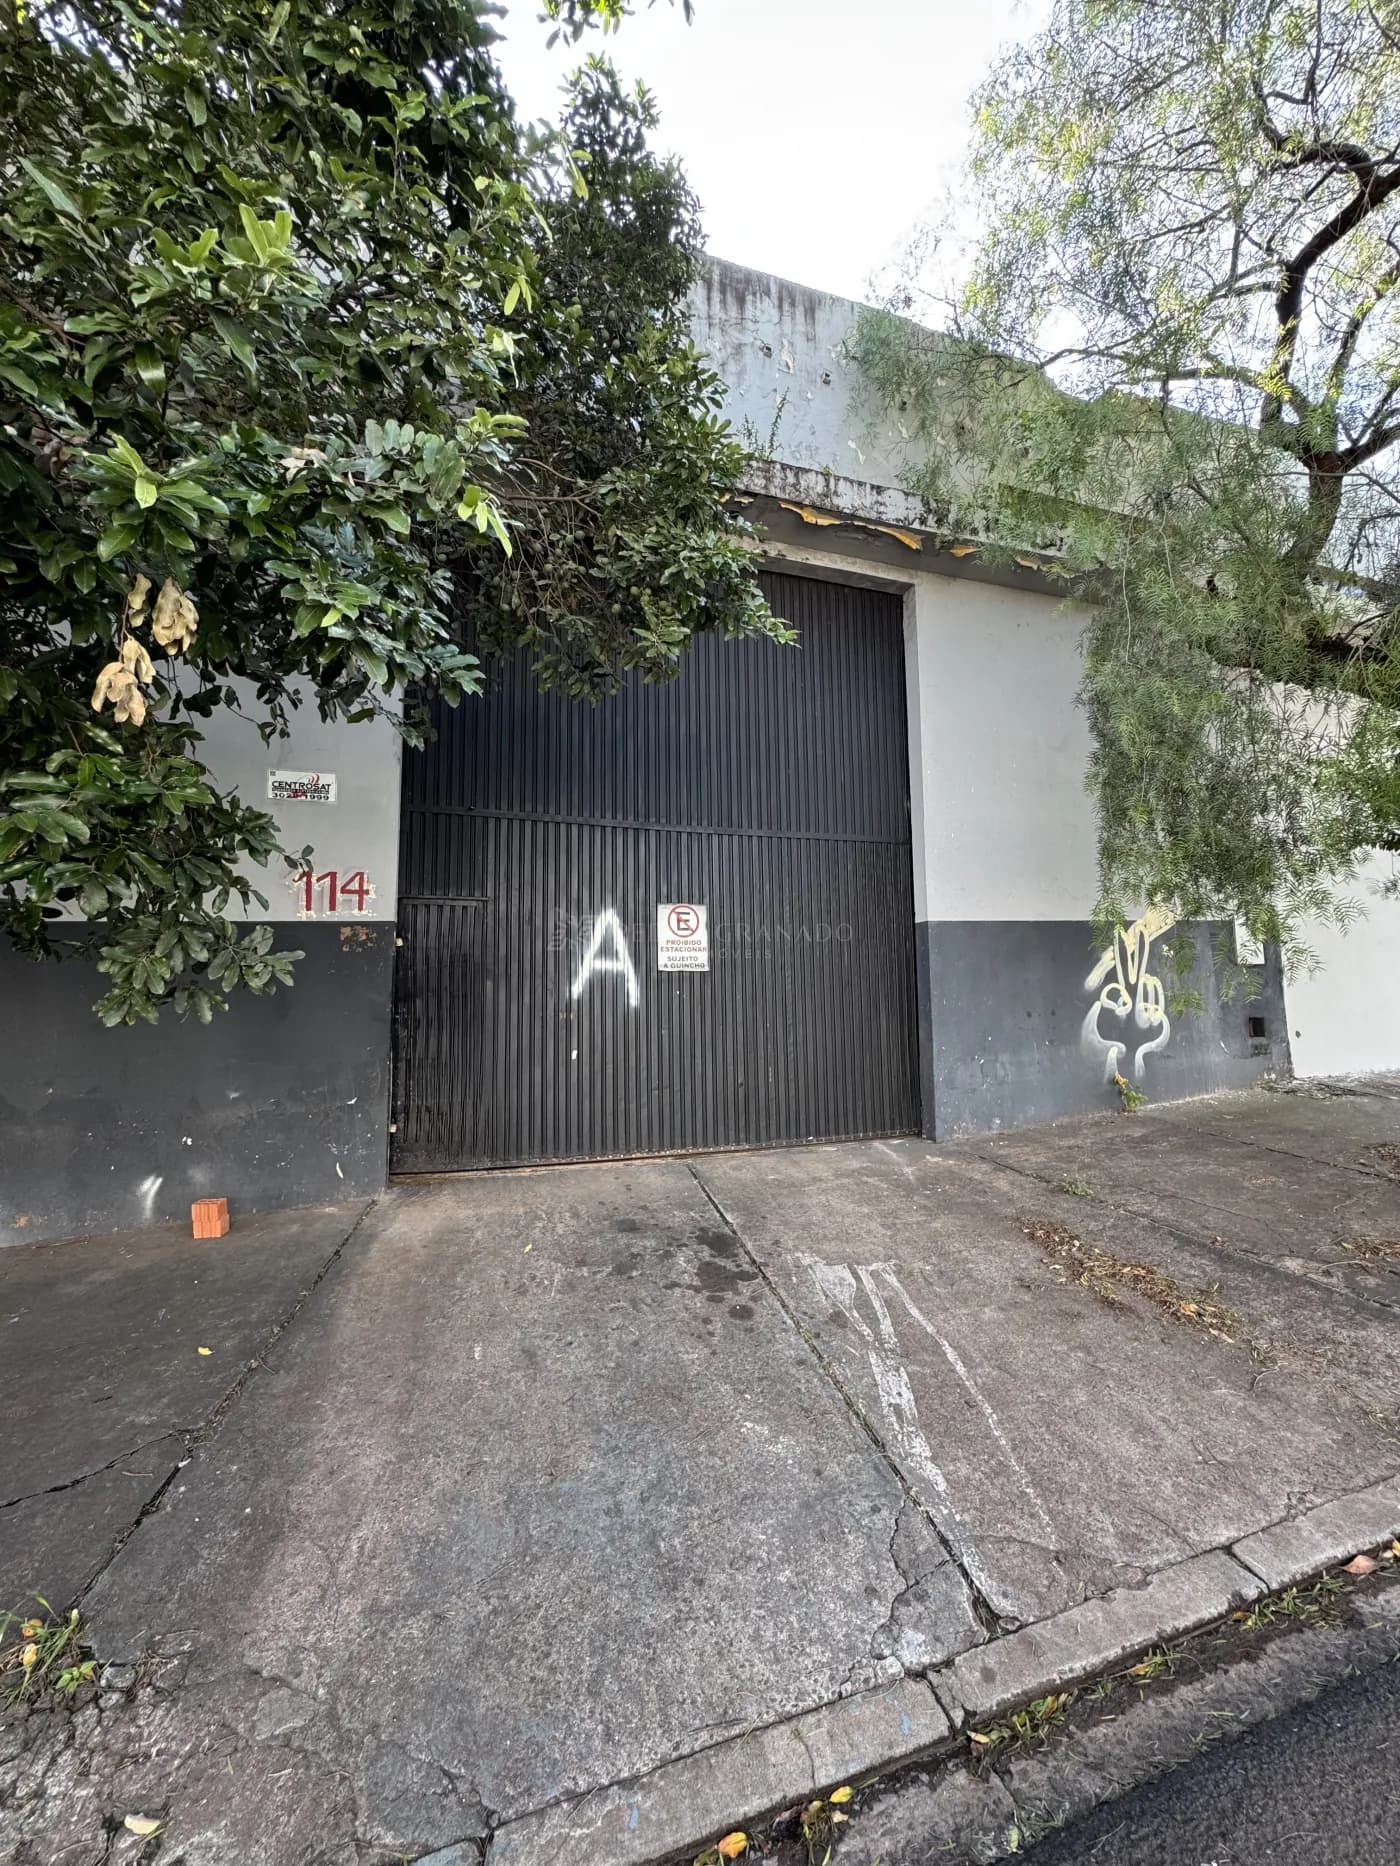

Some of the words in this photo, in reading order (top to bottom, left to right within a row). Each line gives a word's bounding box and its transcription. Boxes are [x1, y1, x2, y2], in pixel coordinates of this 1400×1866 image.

[271, 780, 332, 791] CENTROSAT
[293, 870, 370, 912] 114
[677, 911, 691, 931] E
[570, 906, 641, 1008] A
